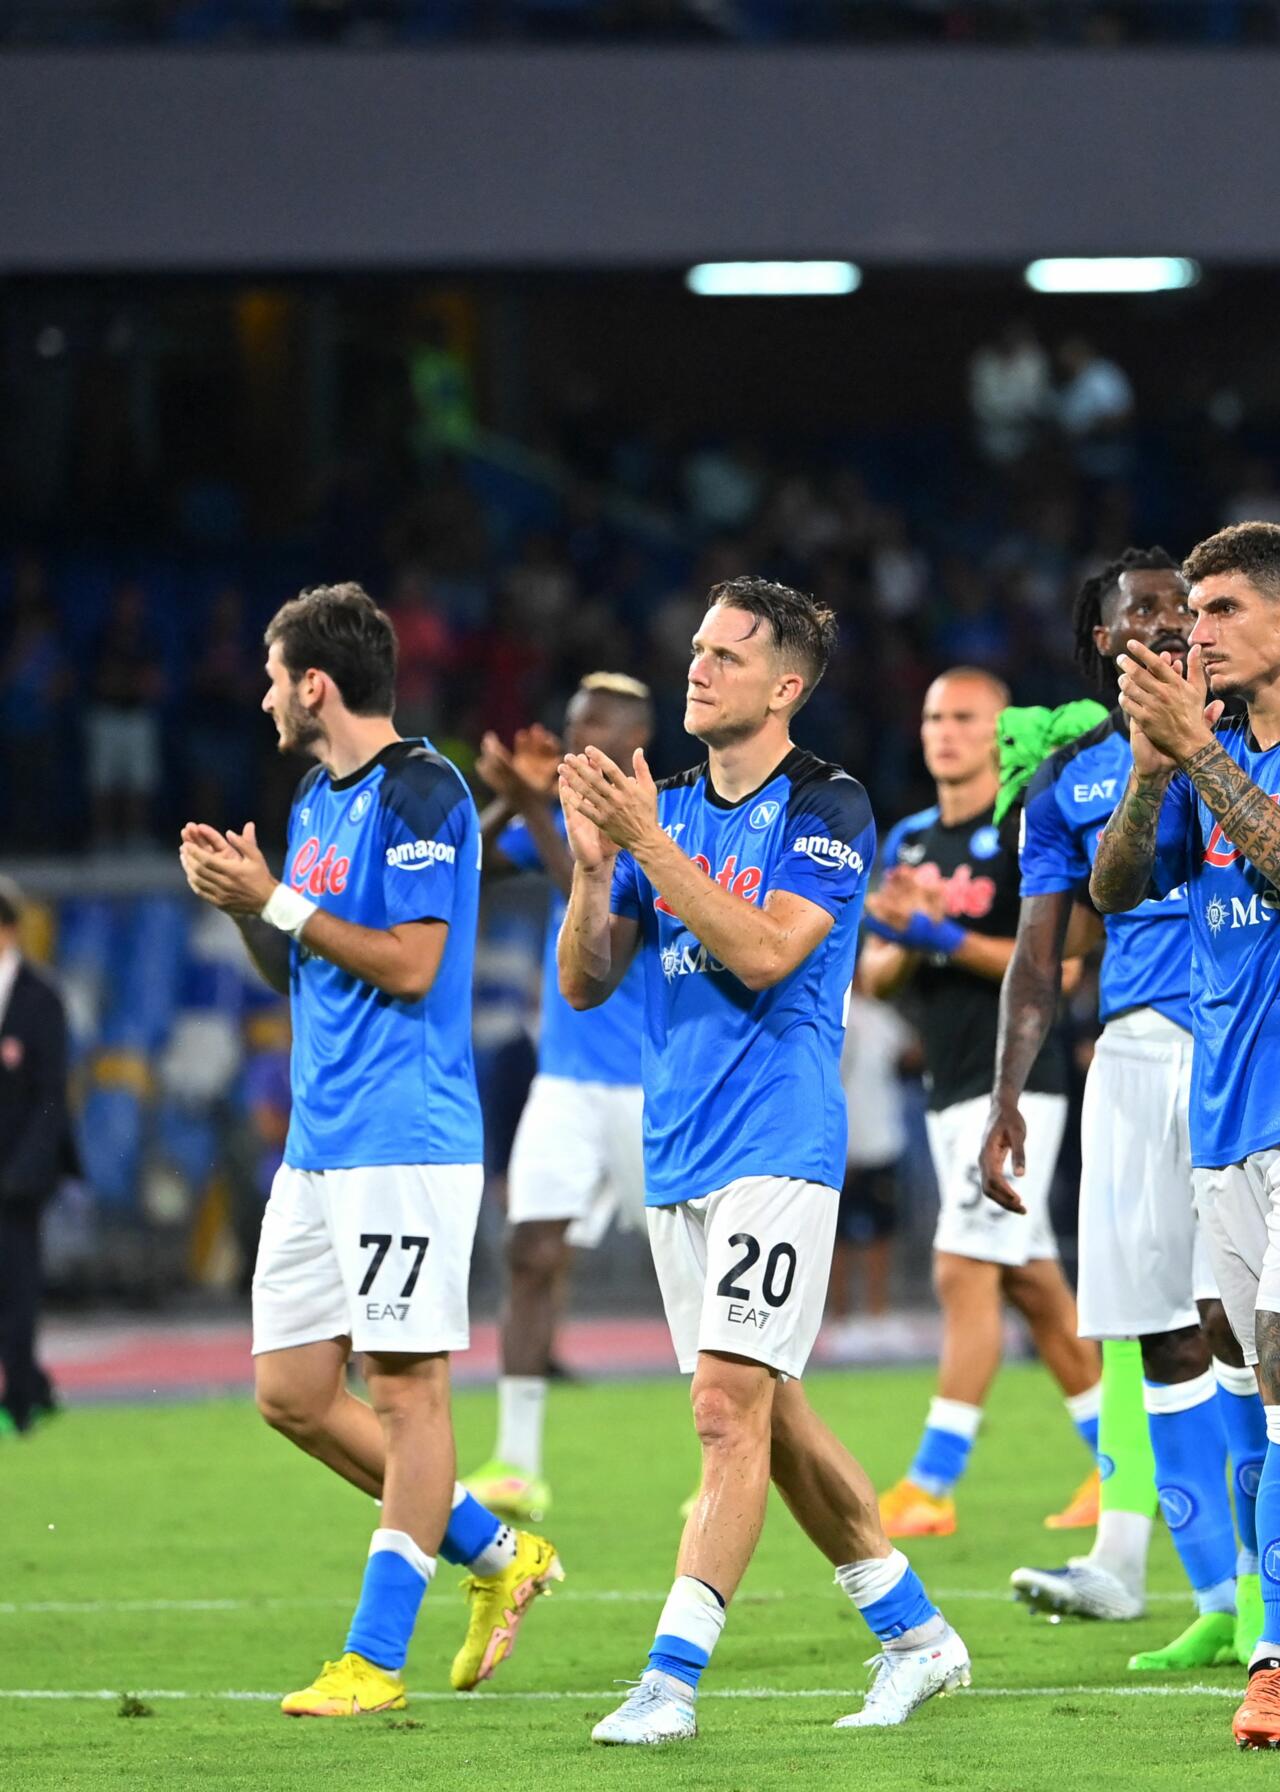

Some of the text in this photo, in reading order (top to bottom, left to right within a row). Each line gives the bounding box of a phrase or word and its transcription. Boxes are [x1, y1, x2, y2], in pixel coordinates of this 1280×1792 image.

[1073, 779, 1117, 802] EA7
[386, 840, 456, 867] amazon
[358, 1233, 430, 1298] 77
[716, 1232, 797, 1308] 20
[366, 1302, 411, 1321] EA7
[727, 1303, 771, 1329] EA7
